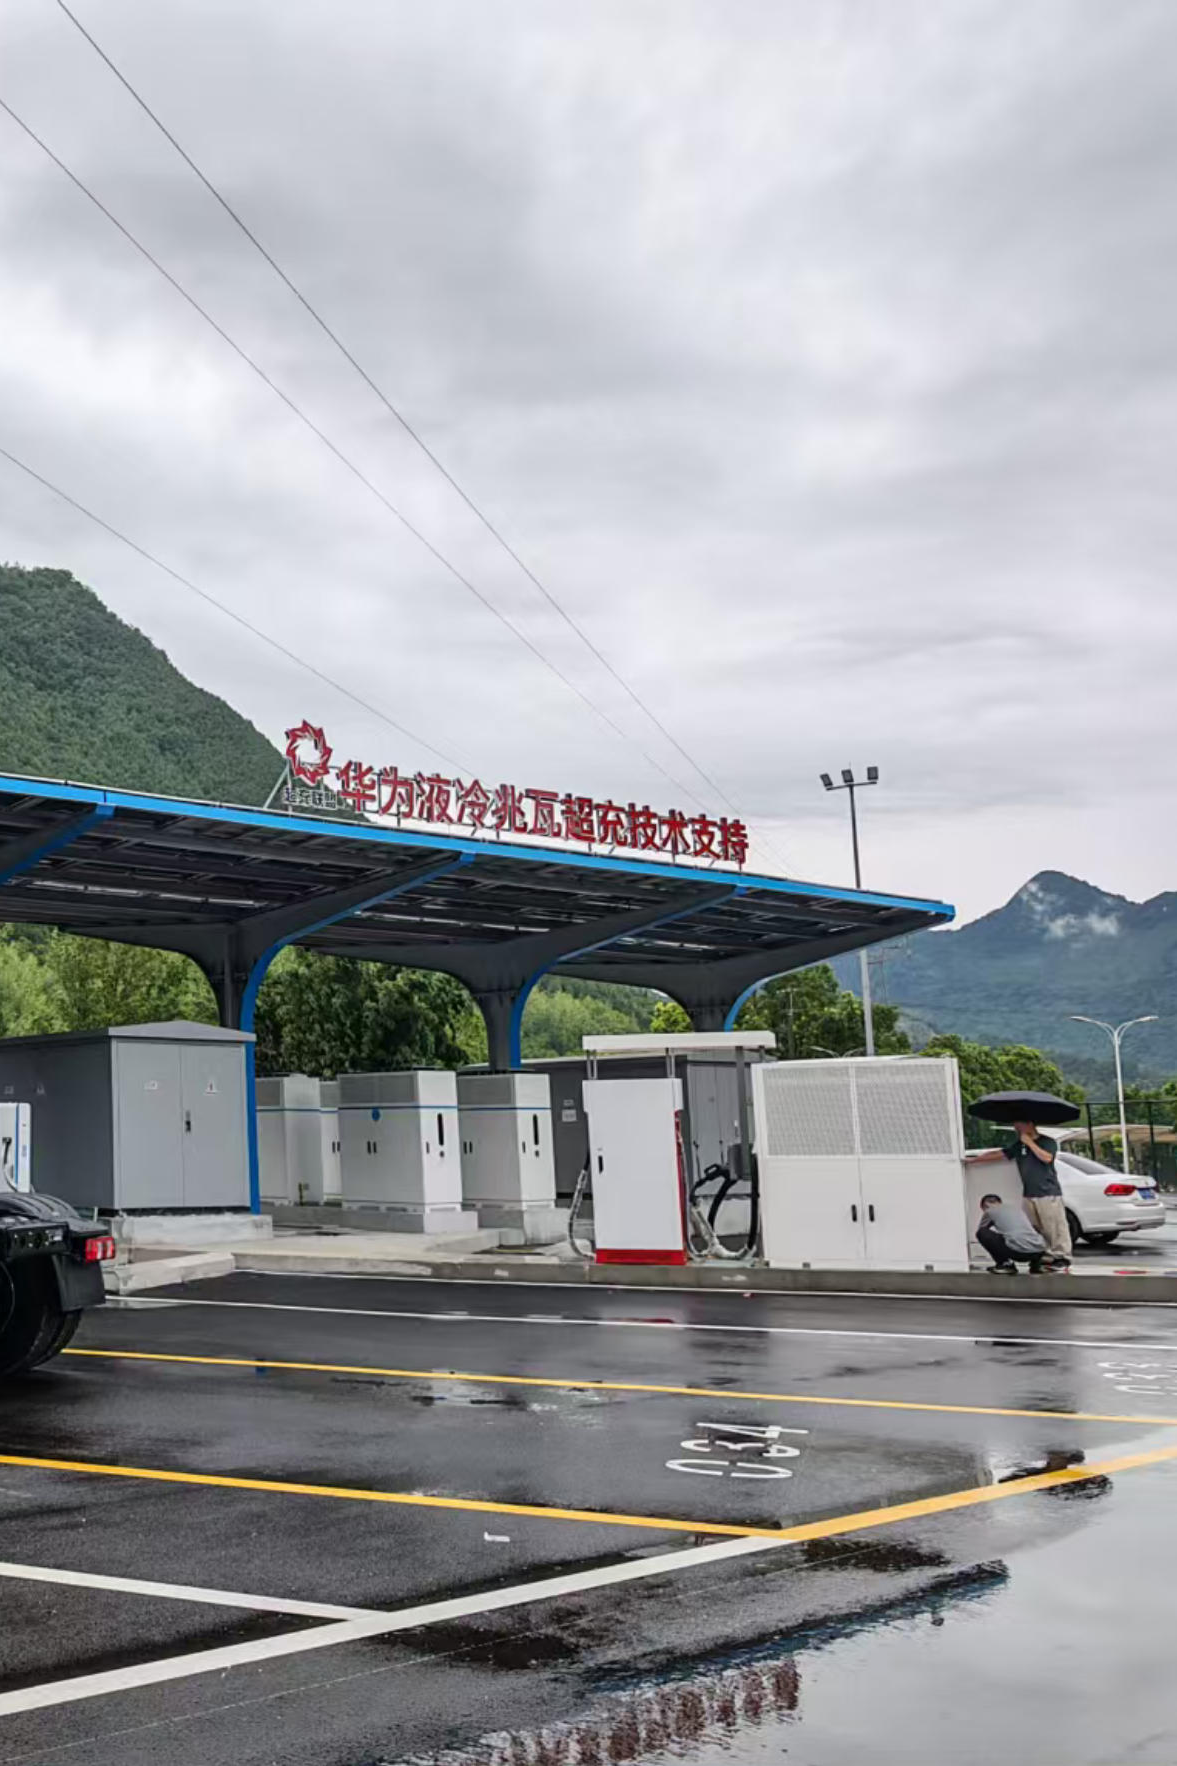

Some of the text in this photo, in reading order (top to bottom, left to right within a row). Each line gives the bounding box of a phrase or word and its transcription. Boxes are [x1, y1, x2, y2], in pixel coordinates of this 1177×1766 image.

[337, 761, 749, 864] 华为液冷兆瓦超充技术支持
[666, 1422, 809, 1479] 034
